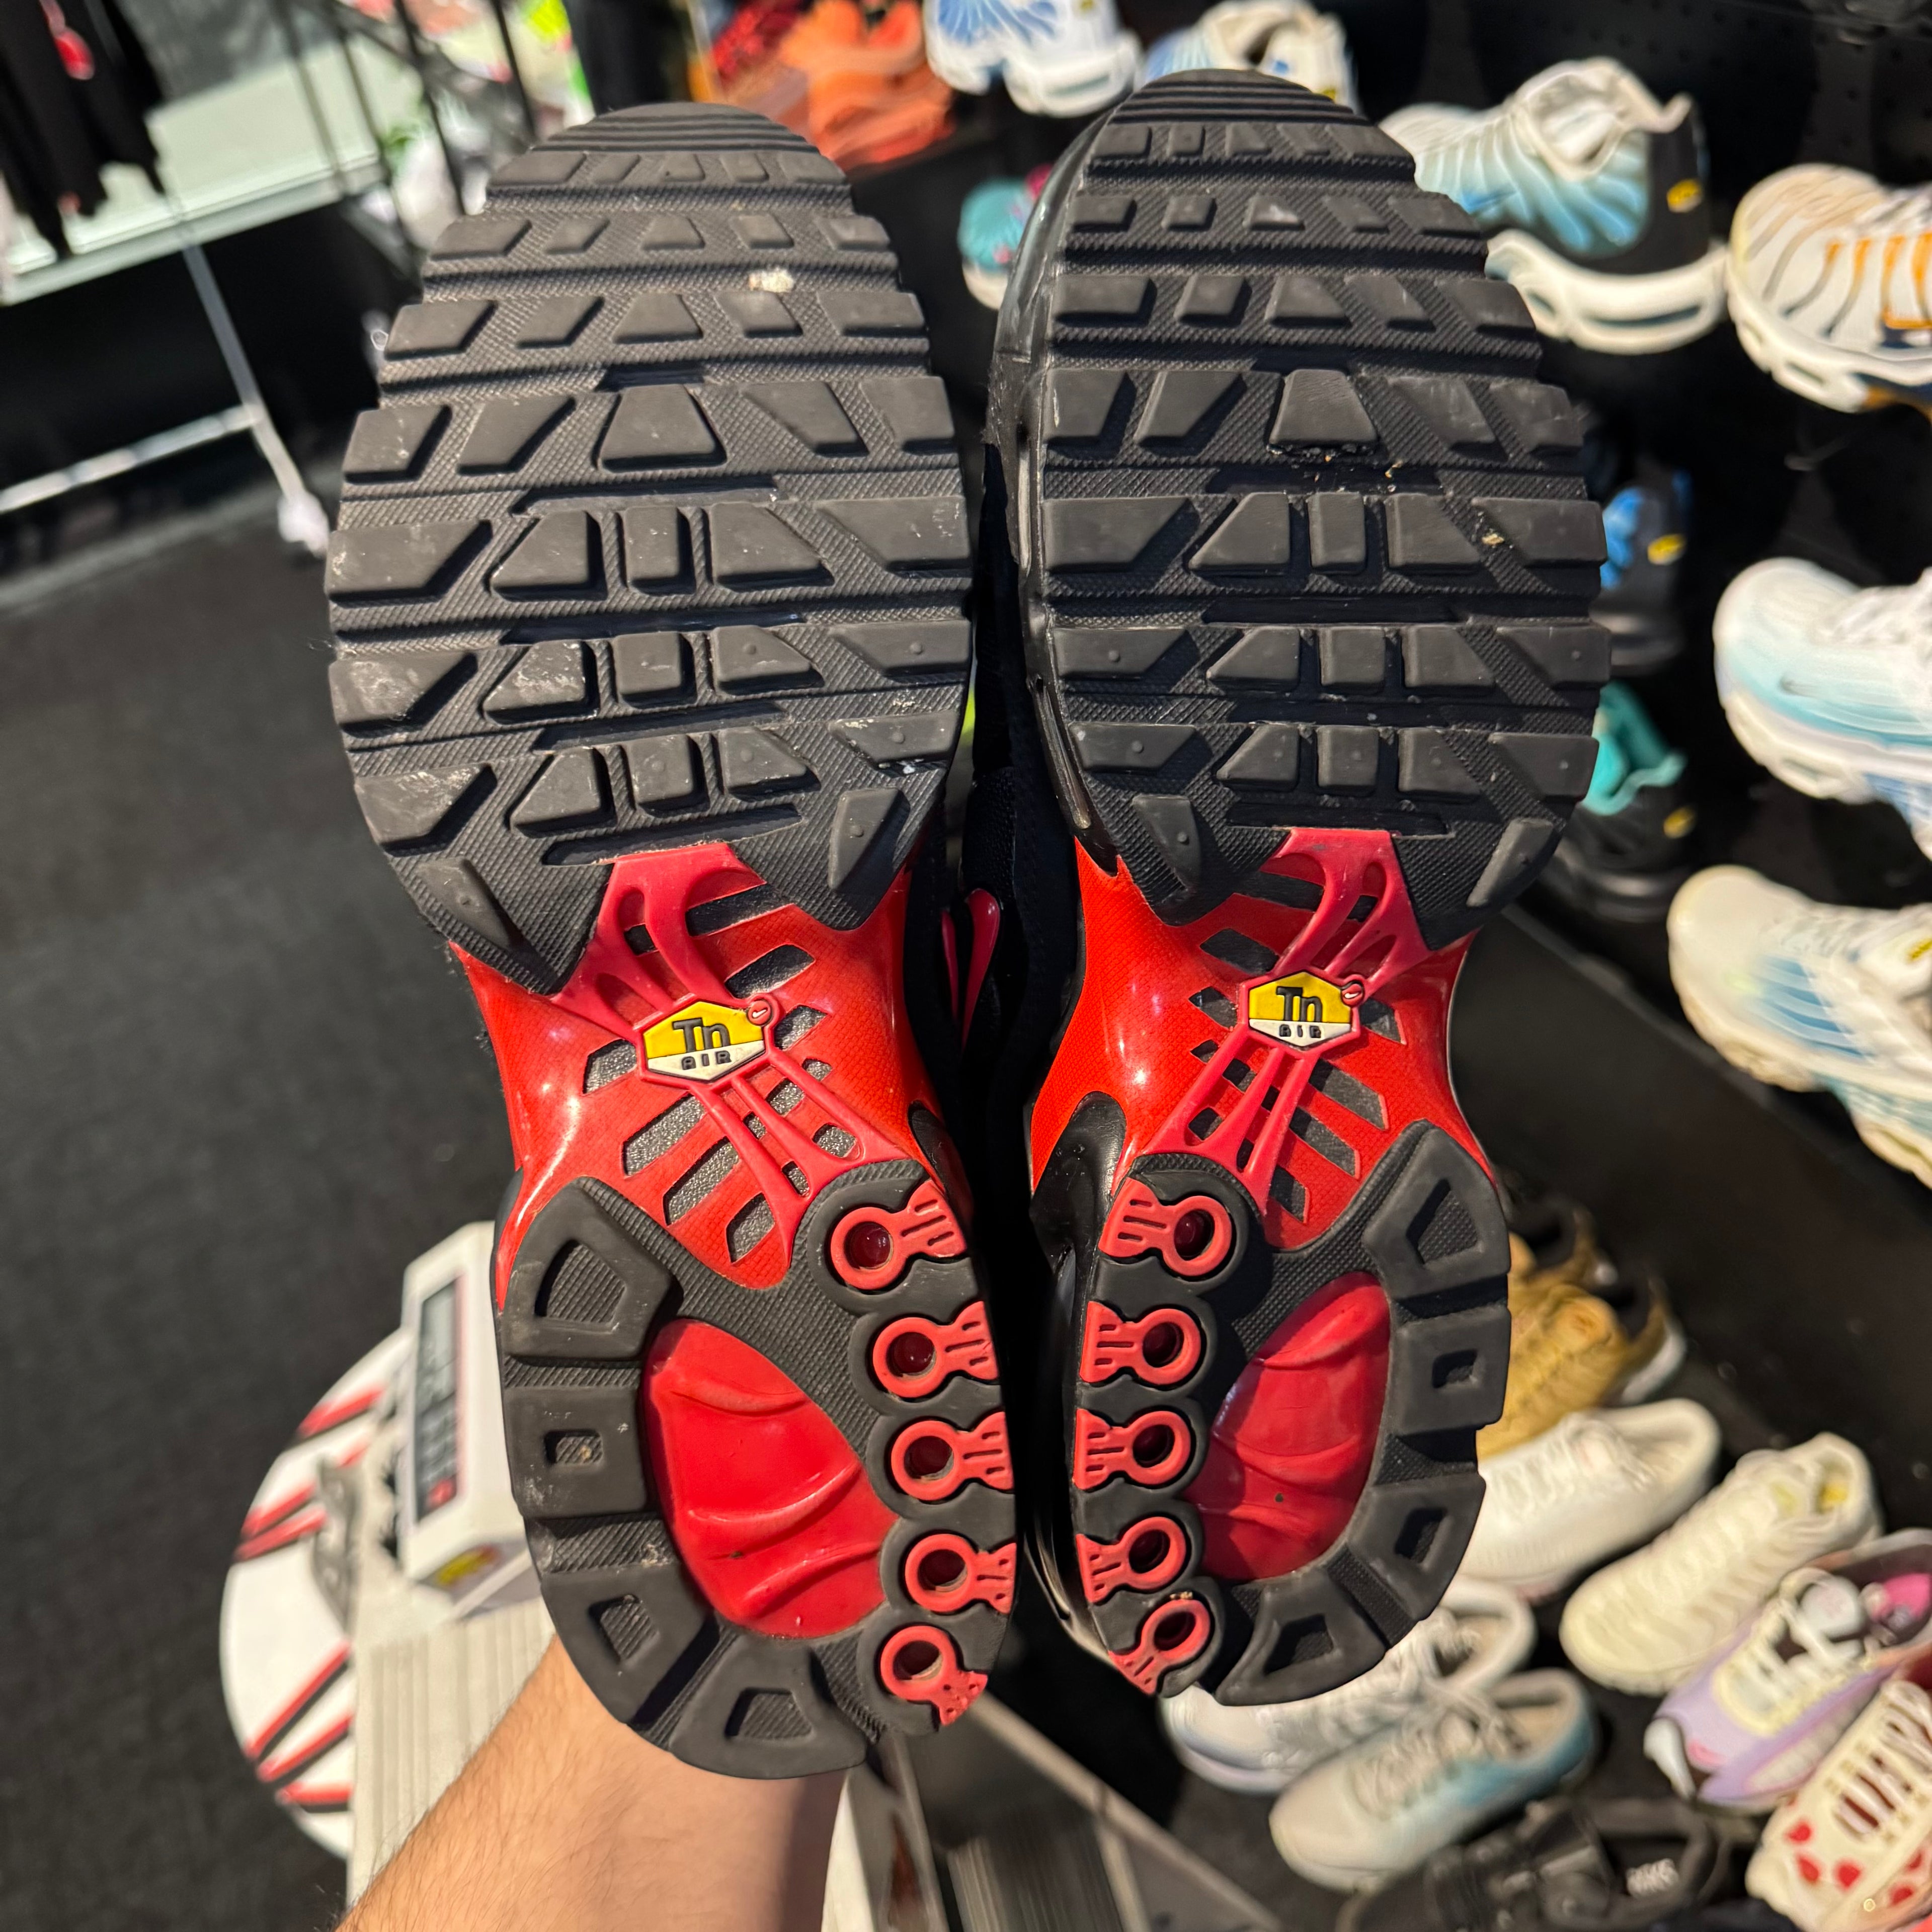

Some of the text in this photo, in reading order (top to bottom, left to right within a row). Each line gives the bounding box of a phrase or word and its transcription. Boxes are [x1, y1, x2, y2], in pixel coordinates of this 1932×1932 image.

[1275, 986, 1323, 1022] Tn
[672, 1017, 731, 1053] Tn
[681, 1050, 732, 1071] AIR
